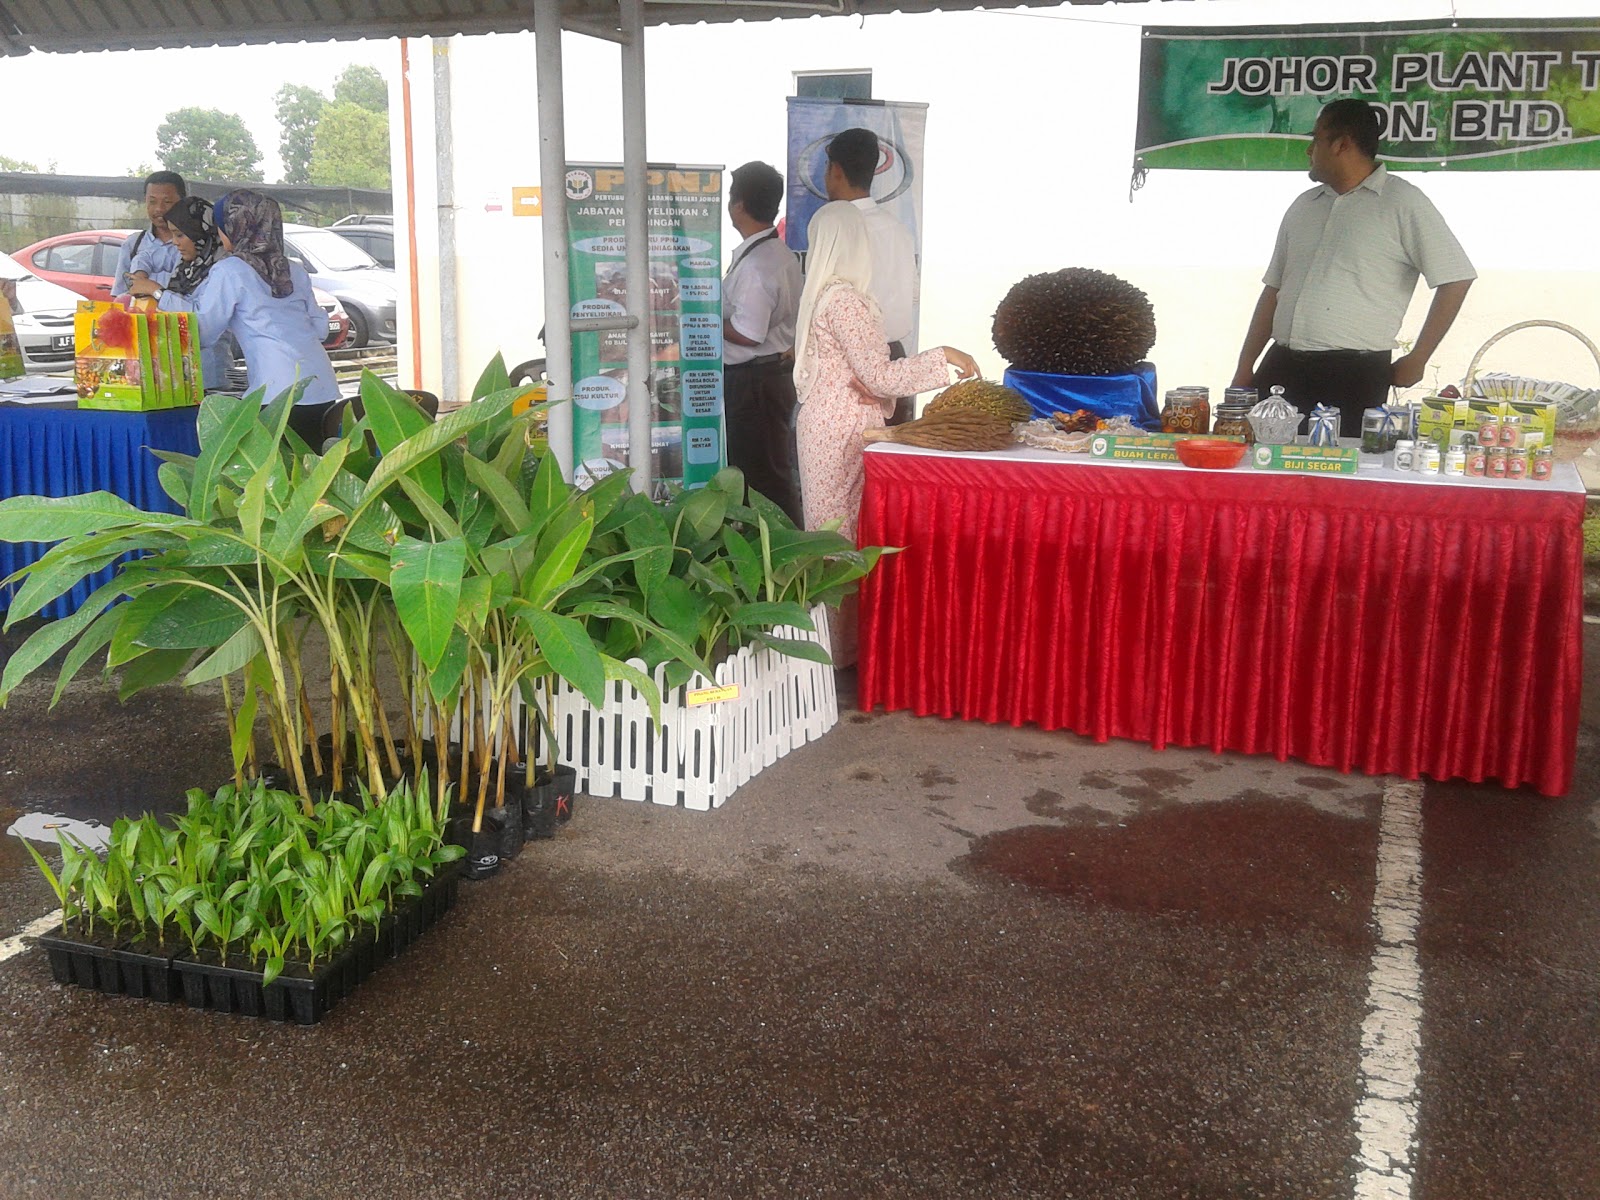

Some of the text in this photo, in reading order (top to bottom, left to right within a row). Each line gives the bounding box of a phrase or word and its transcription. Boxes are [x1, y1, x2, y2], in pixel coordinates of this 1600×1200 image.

[1207, 55, 1377, 95] JOHOR
[1392, 51, 1562, 93] PLANT
[1368, 101, 1574, 141] DN. BHD.
[595, 194, 624, 202] PERTUBU
[648, 194, 674, 202] LADANG
[699, 195, 720, 203] JOHOR
[577, 207, 709, 216] JABATAN YELIDIKAN &
[1114, 450, 1144, 459] BUAH
[1284, 461, 1342, 471] BIJI SEGAR
[555, 795, 569, 816] K
